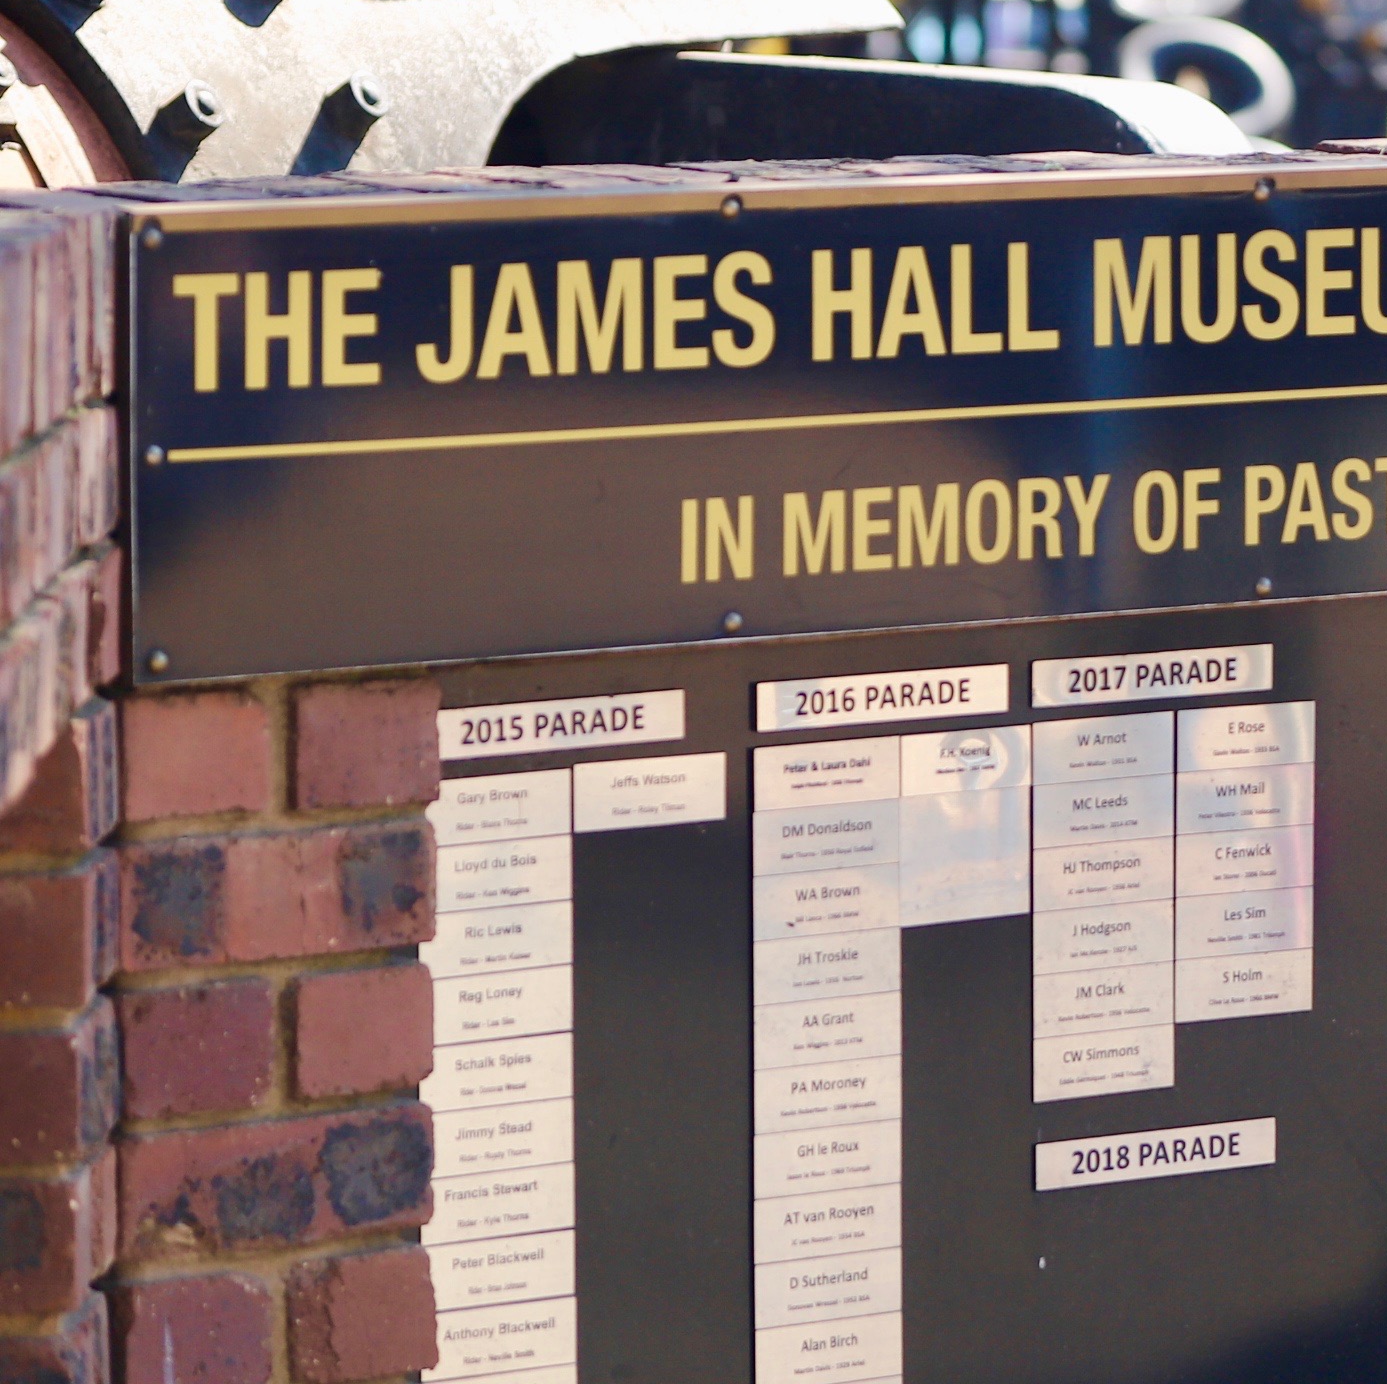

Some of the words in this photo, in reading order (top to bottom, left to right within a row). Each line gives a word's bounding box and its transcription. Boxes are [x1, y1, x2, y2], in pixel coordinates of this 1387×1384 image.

[173, 269, 380, 391] THE
[416, 251, 774, 383] JAMES
[813, 243, 1059, 360] HALL
[681, 495, 754, 584] IN
[783, 475, 1110, 577] MEMORY
[1134, 469, 1220, 553] OF
[1067, 664, 1126, 693] 2017
[1135, 656, 1238, 688] PARADE
[794, 686, 855, 716] 2016
[864, 677, 971, 710] PARADE
[460, 714, 524, 745] 2015
[533, 703, 646, 738] PARADE
[456, 791, 485, 805] Gary
[488, 788, 528, 804] Brown
[1071, 796, 1092, 811] MC
[1094, 793, 1128, 809] Leeds
[781, 823, 804, 838] DM
[806, 818, 872, 837] Donaldson
[1214, 846, 1223, 860] C
[1224, 842, 1272, 859] Fenwick
[794, 887, 818, 902] WA
[820, 885, 860, 899] Brown
[1074, 984, 1092, 1000] JM
[1094, 980, 1125, 998] Clark
[1062, 1049, 1083, 1064] CW
[1085, 1044, 1140, 1061] Simmons
[1071, 1144, 1130, 1175] 2018
[1138, 1131, 1241, 1167] PARADE
[443, 1185, 489, 1202] Francis
[492, 1179, 538, 1196] Stewart
[451, 1256, 484, 1270] Peter
[486, 1247, 544, 1266] Blackwell
[788, 1276, 800, 1290] D
[801, 1266, 868, 1288] Sutherland
[442, 1327, 494, 1342] Anthony
[497, 1316, 556, 1335] Blackwell
[800, 1337, 826, 1352] Alan
[829, 1332, 858, 1348] Birch
